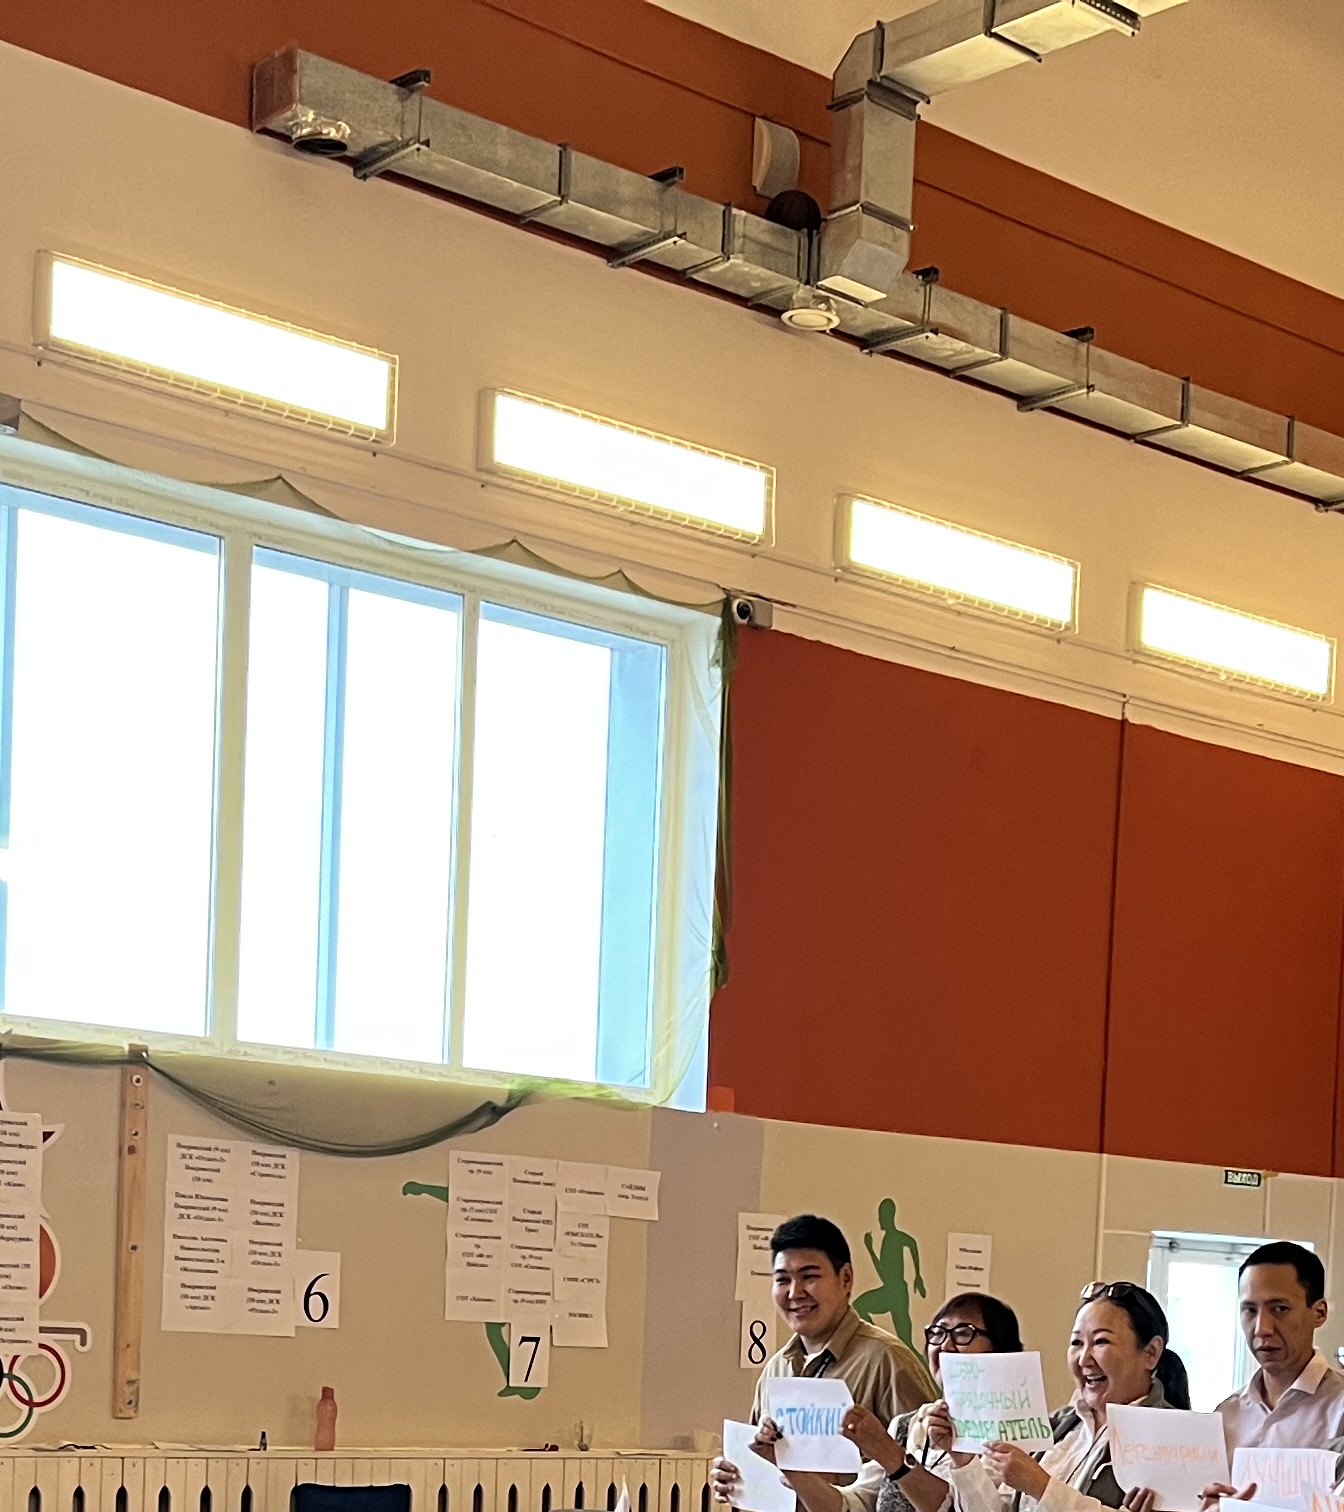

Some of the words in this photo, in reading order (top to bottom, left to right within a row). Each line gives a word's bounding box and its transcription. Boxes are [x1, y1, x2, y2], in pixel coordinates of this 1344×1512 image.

[304, 1273, 330, 1323] 6
[518, 1336, 541, 1383] 7
[748, 1320, 767, 1364] 8
